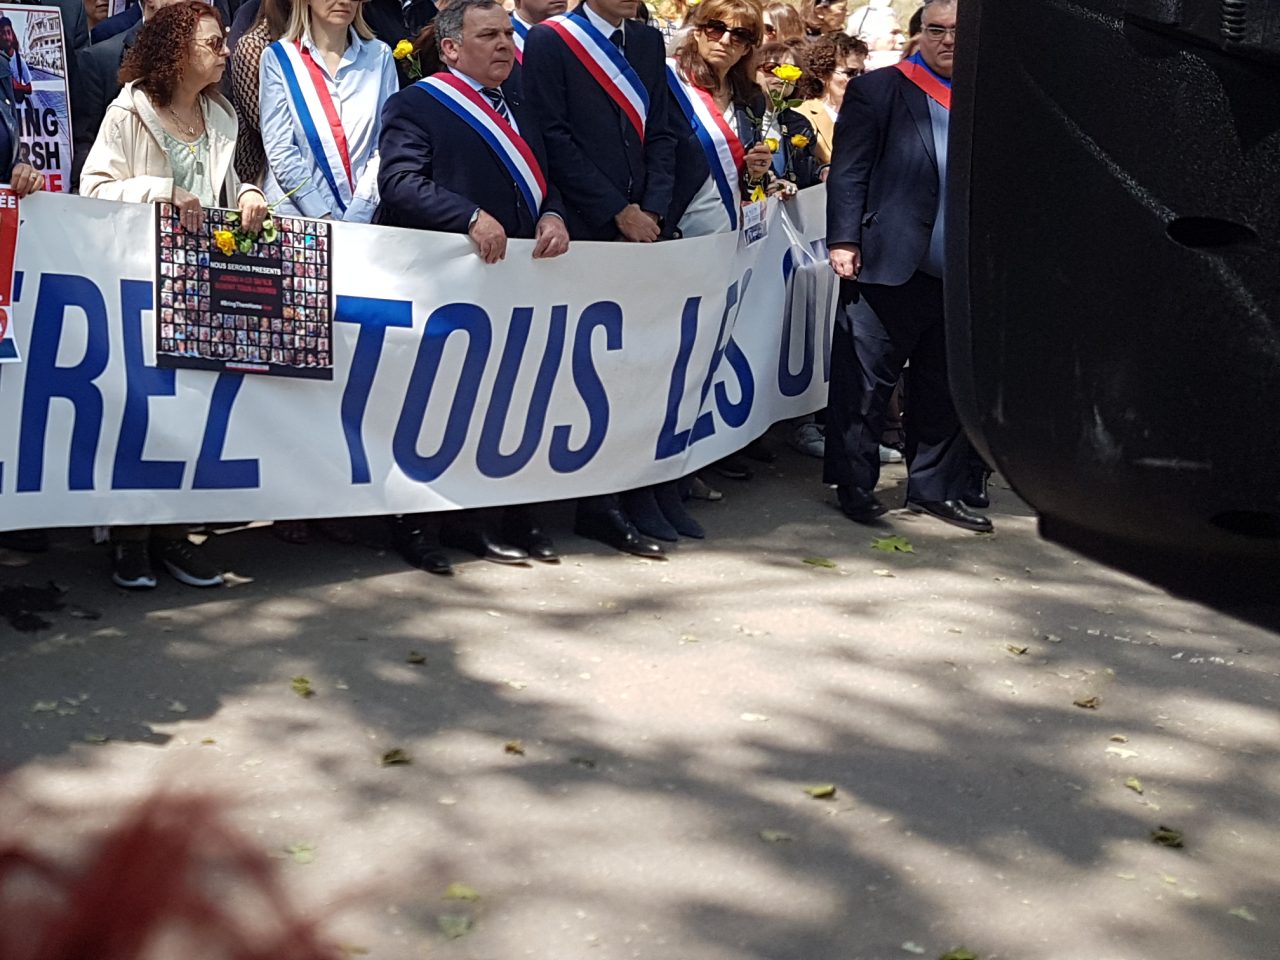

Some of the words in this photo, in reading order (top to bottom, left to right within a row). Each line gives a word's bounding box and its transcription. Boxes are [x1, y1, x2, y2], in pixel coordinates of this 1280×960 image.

[210, 261, 227, 270] NOUS
[227, 263, 251, 272] SERONS
[251, 265, 282, 276] PRESENTS
[334, 294, 623, 485] TOUS
